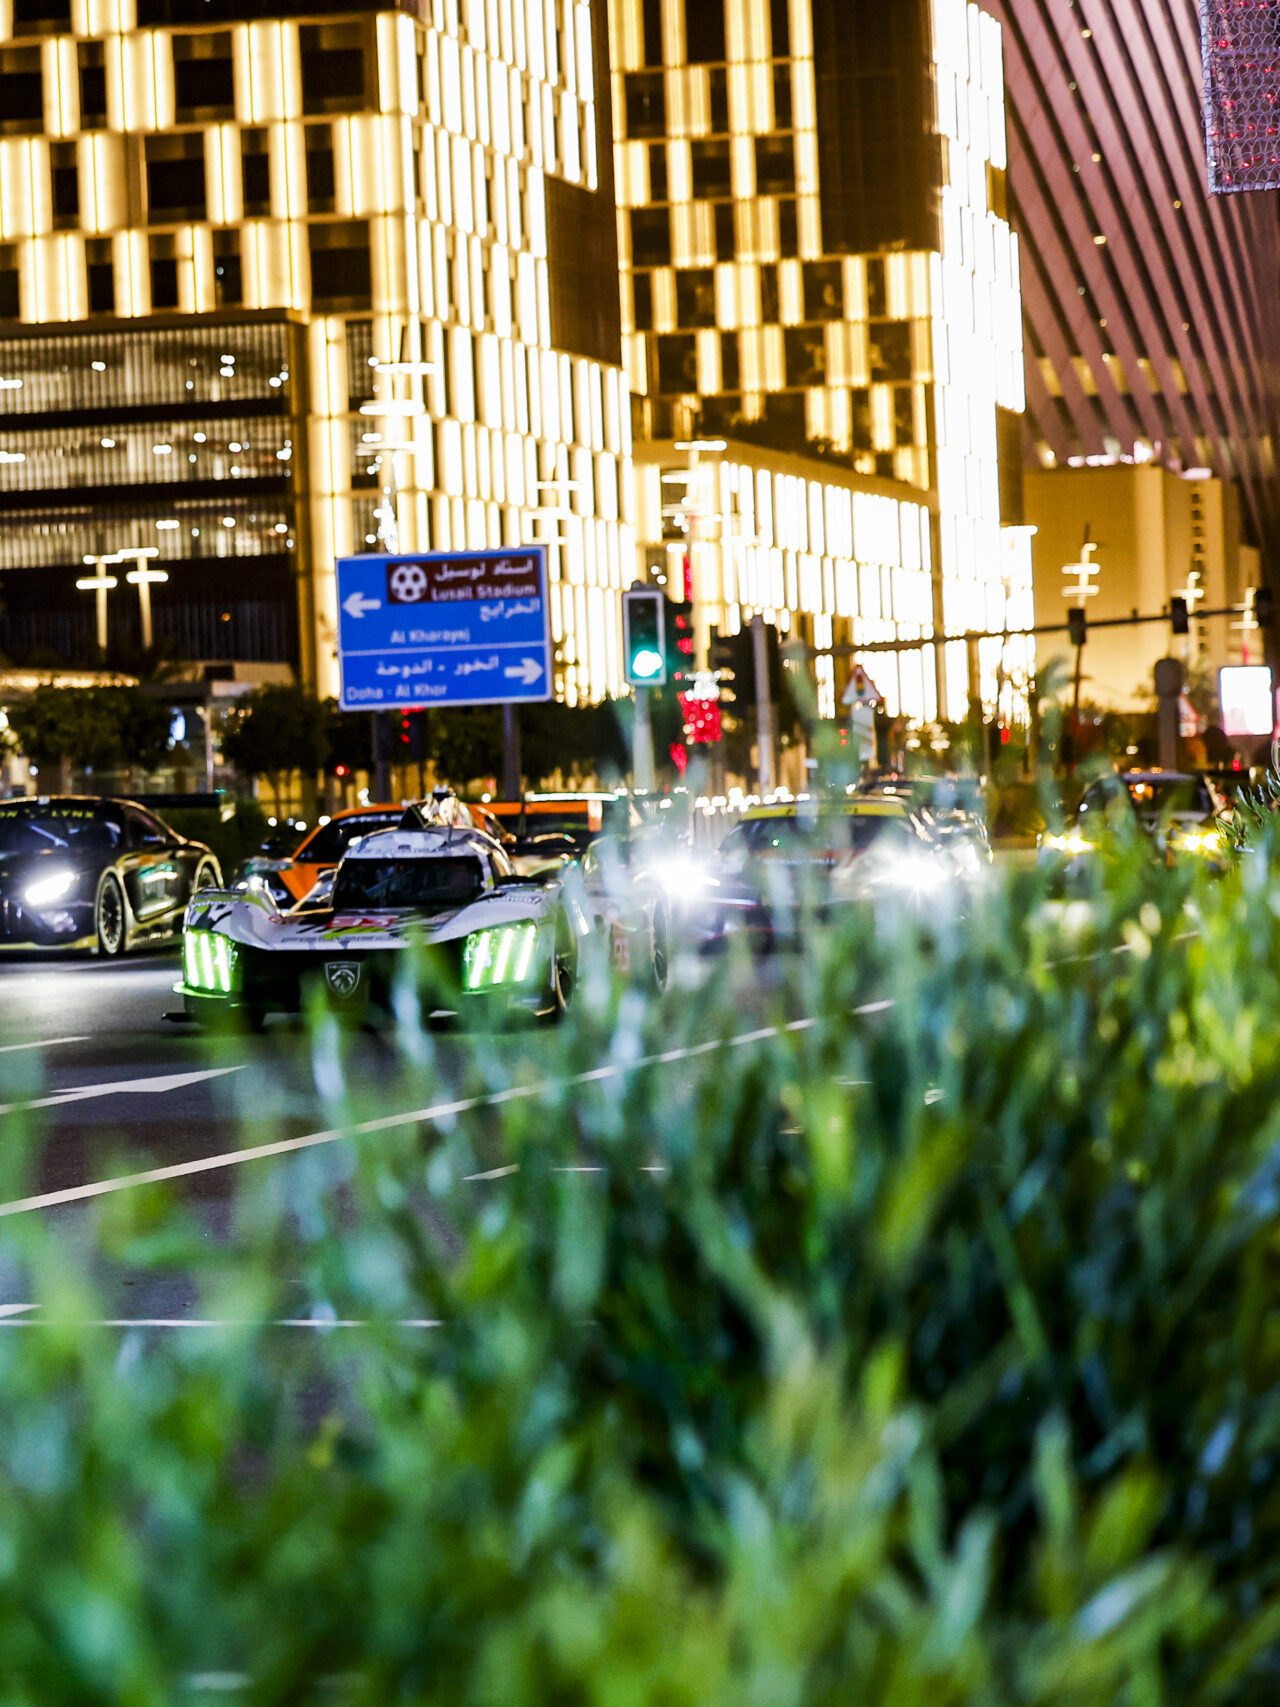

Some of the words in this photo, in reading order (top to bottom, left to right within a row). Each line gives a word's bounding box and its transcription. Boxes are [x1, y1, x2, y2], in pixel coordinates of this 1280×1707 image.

[431, 587, 472, 602] Lusail
[477, 583, 536, 600] Stadium
[346, 686, 383, 701] Doha
[414, 682, 448, 697] Khor
